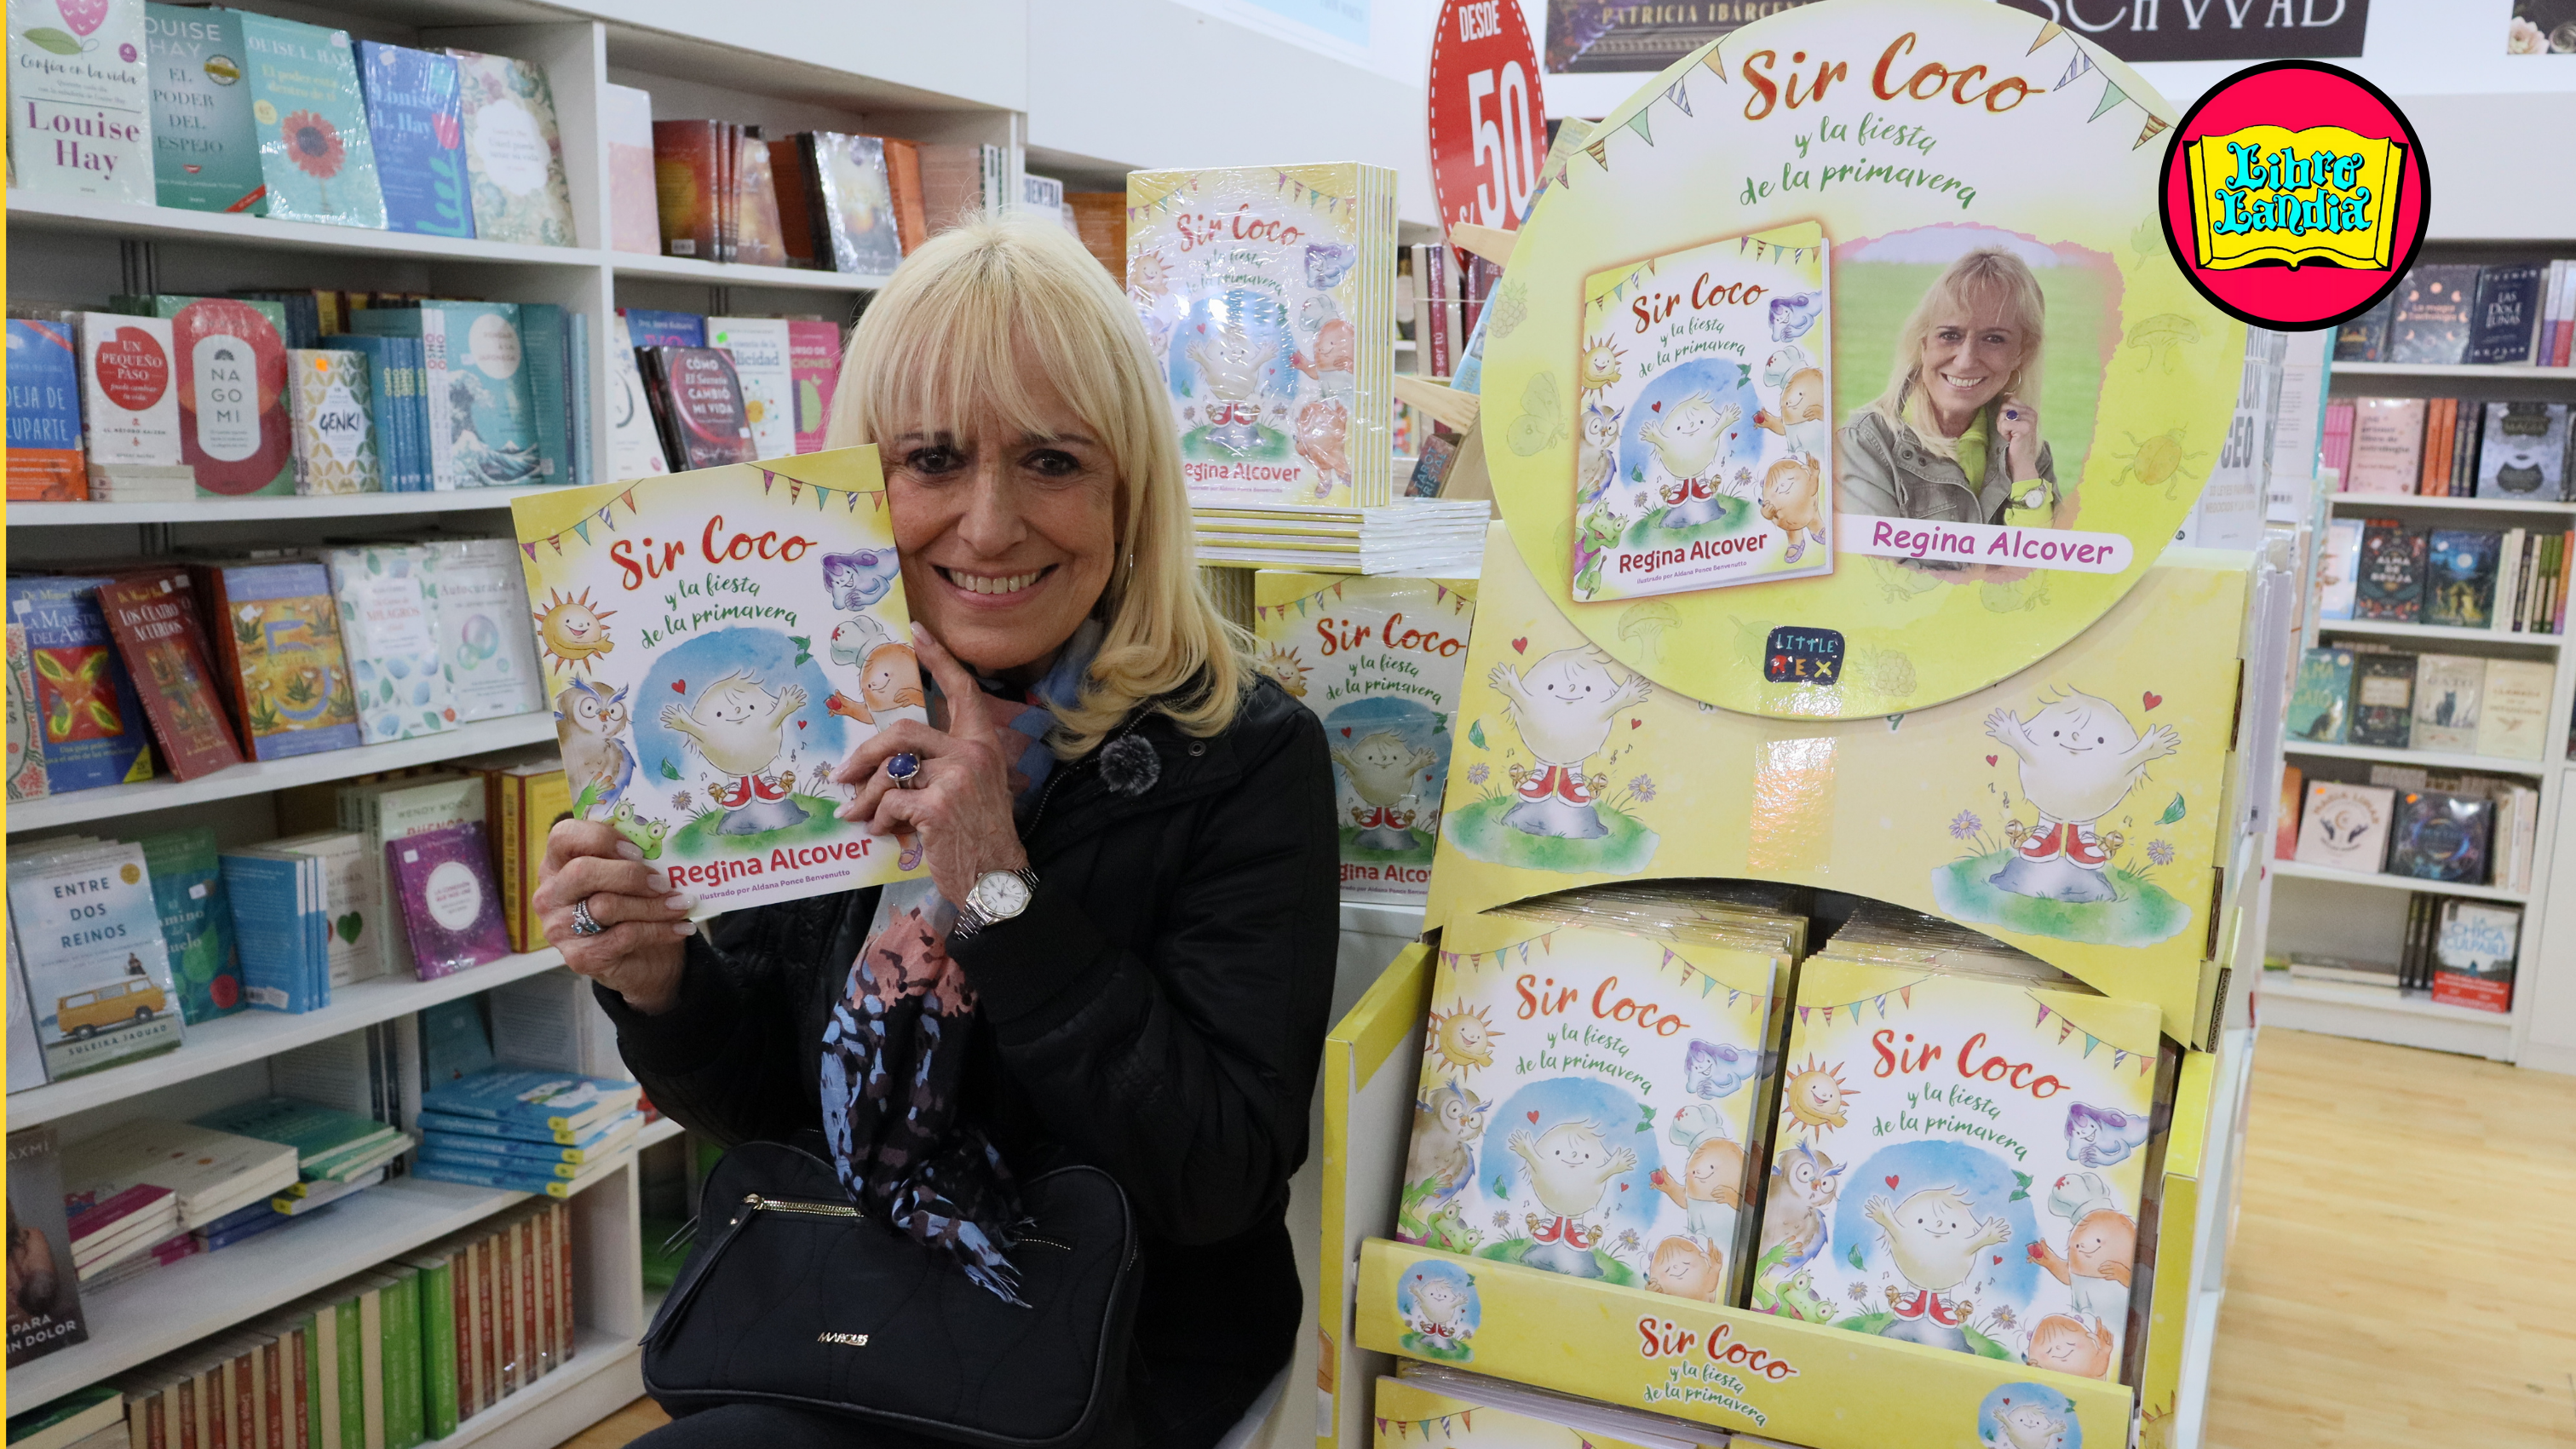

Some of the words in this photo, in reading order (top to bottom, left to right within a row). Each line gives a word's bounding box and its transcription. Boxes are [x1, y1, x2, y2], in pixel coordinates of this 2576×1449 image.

[145, 16, 221, 42] OUISE
[1458, 1, 1502, 43] DESDE
[1601, 4, 1698, 24] PATRICIA
[88, 63, 102, 78] la
[107, 70, 137, 84] vida
[169, 68, 193, 83] EL
[1743, 50, 1847, 121] Sir
[1872, 32, 2045, 112] Coco
[152, 89, 215, 108] PODER
[26, 101, 141, 142] Louise
[169, 114, 206, 129] DEL
[1795, 132, 1812, 158] y
[1820, 116, 1846, 142] la
[1857, 112, 1936, 156] fiesta
[55, 139, 118, 181] Hay
[157, 135, 224, 153] ESPEJO
[1468, 60, 1533, 229] 50
[1739, 177, 1776, 205] de
[1782, 162, 1809, 192] la
[1820, 158, 1977, 210] primavera
[1177, 214, 1222, 252] Sir
[1232, 203, 1305, 245] Coco
[1632, 293, 1680, 333] Sir
[1692, 273, 1769, 309] Coco
[123, 340, 141, 352] UN
[1660, 333, 1669, 347] y
[1671, 323, 1684, 338] la
[1688, 317, 1725, 335] fiesta
[101, 352, 163, 368] PEQUEÑO
[118, 369, 150, 381] PASO
[1638, 362, 1655, 379] de
[1657, 351, 1670, 366] la
[1675, 340, 1745, 363] primavera
[46, 387, 66, 411] DE
[1184, 463, 1228, 482] egina
[1233, 462, 1301, 482] Alcover
[610, 538, 685, 590] Sir
[701, 515, 818, 565] Coco
[1619, 548, 1685, 574] Regina
[1690, 533, 1768, 561] Alcover
[1872, 520, 1975, 557] Regina
[1987, 530, 2113, 565] Alcover
[1636, 573, 1663, 585] Ilustrado
[1663, 573, 1673, 582] por
[1673, 569, 1694, 578] Aldana
[1694, 566, 1712, 574] Ponce
[1713, 561, 1747, 572] Benvenutto
[664, 592, 678, 612] y
[679, 579, 700, 598] la
[705, 572, 761, 596] fiesta
[641, 629, 664, 649] de
[664, 614, 687, 635] la
[693, 605, 797, 632] primavera
[1317, 618, 1371, 656] Sir
[1383, 612, 1467, 658] Coco
[1349, 663, 1358, 676] y
[1360, 654, 1375, 670] la
[1380, 653, 1420, 678] fiesta
[1771, 654, 1832, 678] REX
[1325, 685, 1343, 701] de
[1346, 678, 1361, 694] la
[1365, 677, 1442, 705] primavera
[667, 855, 763, 888] Regina
[770, 837, 872, 872] Alcover
[1340, 863, 1379, 883] gina
[1384, 864, 1431, 884] Alco
[53, 877, 111, 899] ENTRE
[699, 890, 735, 901] Ilustrado
[737, 885, 750, 896] por
[751, 881, 779, 893] Aldana
[780, 876, 804, 888] Ponce
[805, 868, 850, 883] Benvenutto
[70, 903, 107, 922] DOS
[60, 923, 127, 949] REINOS
[1515, 974, 1578, 1021] Sir
[1592, 975, 1691, 1037] Coco
[68, 1037, 118, 1056] SULEIKA
[124, 1024, 168, 1042] JAOUAD
[1547, 1032, 1558, 1049] y
[1561, 1023, 1578, 1041] la
[1584, 1024, 1630, 1057] fiesta
[1515, 1056, 1537, 1075] de
[1540, 1050, 1556, 1069] la
[1562, 1054, 1653, 1095] primavera
[1872, 1029, 1941, 1078] Sir
[1957, 1032, 2071, 1098] Coco
[1907, 1090, 1919, 1109] y
[1924, 1082, 1942, 1101] la
[1949, 1084, 2001, 1120] fiesta
[6, 1141, 49, 1162] AXMI
[1872, 1116, 1895, 1136] de
[1900, 1110, 1918, 1131] la
[1924, 1115, 2028, 1162] primavera
[11, 1314, 52, 1334] PARA
[25, 1320, 78, 1348] DOLOR
[1638, 1318, 1695, 1356] Sir
[1707, 1324, 1797, 1379] Coco
[1670, 1366, 1678, 1382] y
[1682, 1360, 1698, 1377] la
[1703, 1363, 1745, 1394] fiesta
[1644, 1385, 1661, 1401] de
[1665, 1382, 1680, 1399] la
[1685, 1387, 1766, 1426] primavera
